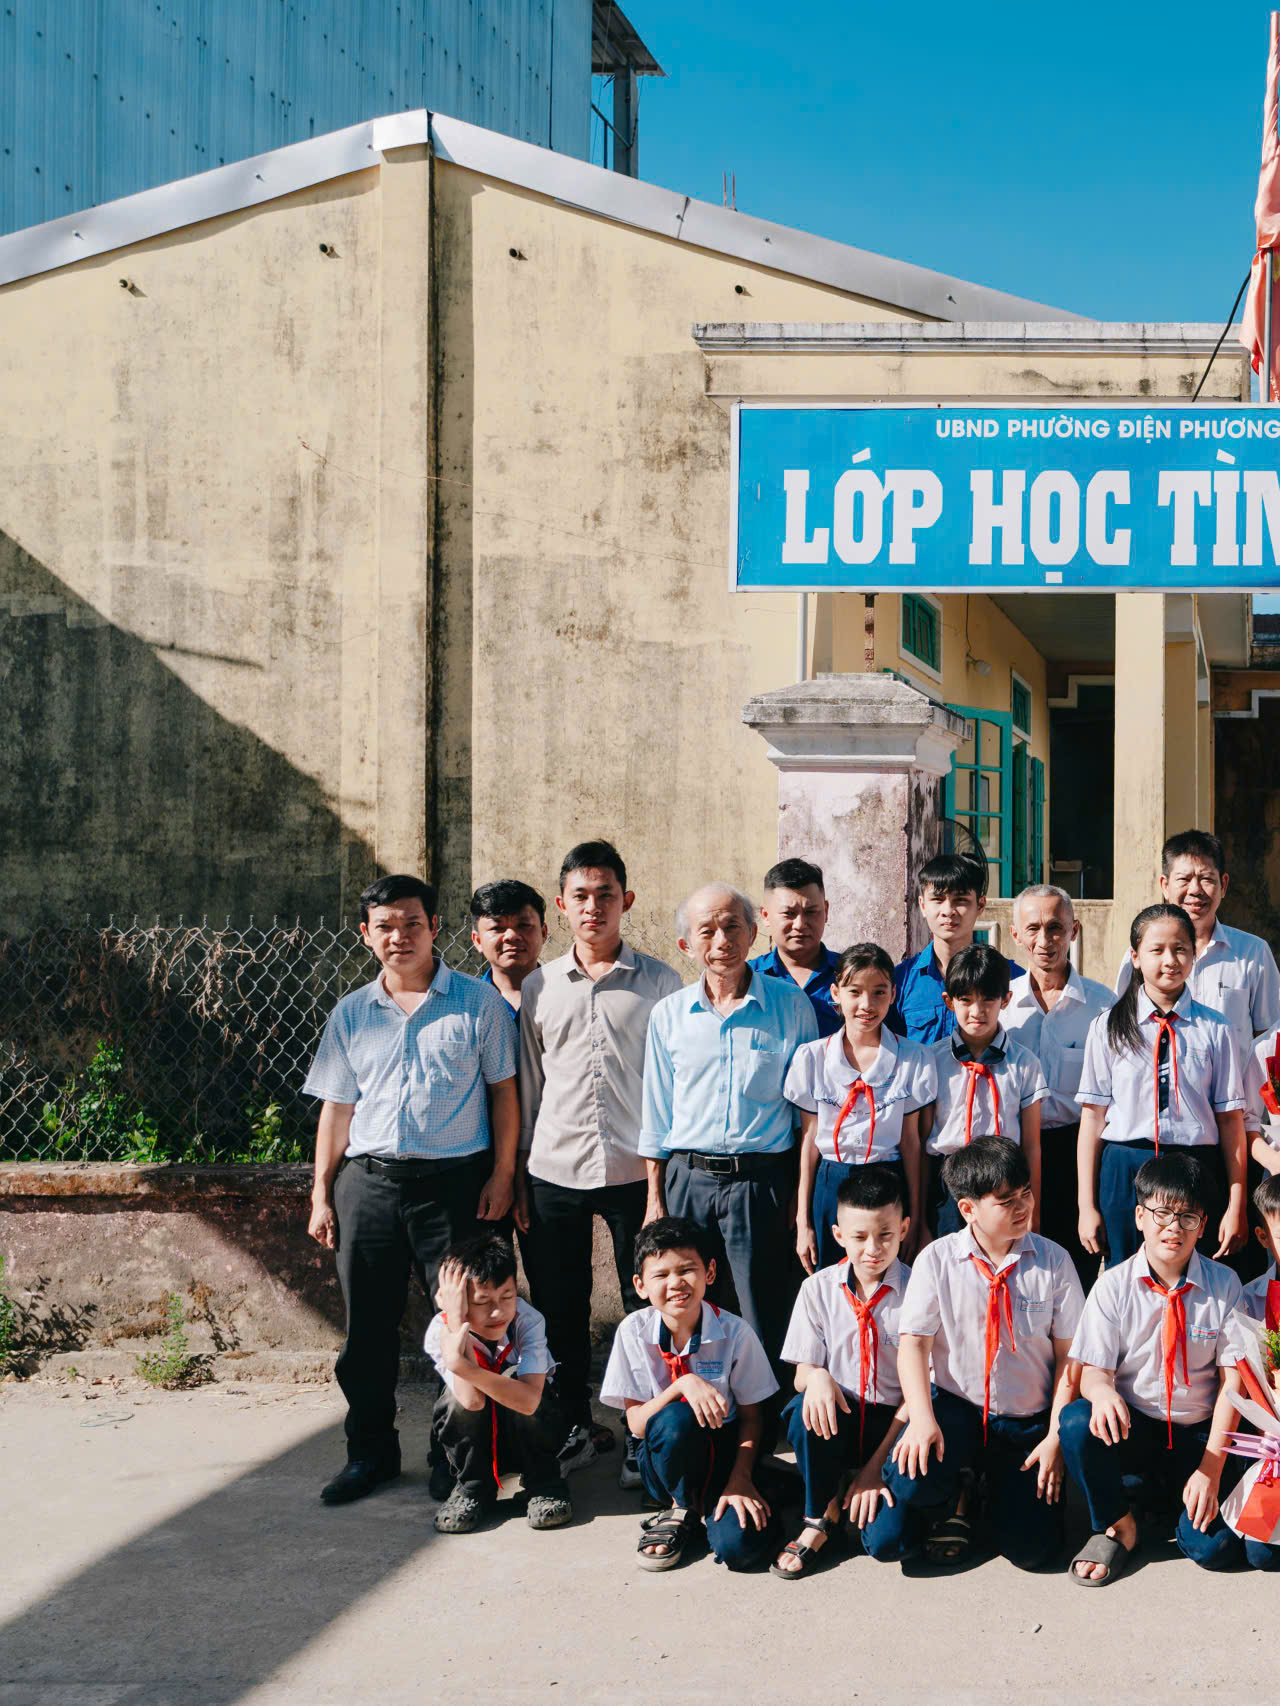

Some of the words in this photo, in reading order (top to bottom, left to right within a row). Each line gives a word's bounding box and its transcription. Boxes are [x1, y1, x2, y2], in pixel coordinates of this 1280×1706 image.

[937, 419, 1000, 438] UBND
[1007, 414, 1111, 439] PHƯỜNG
[1117, 414, 1172, 444] ĐIỆN
[781, 447, 943, 565] LỚP
[968, 469, 1132, 584] HỌC
